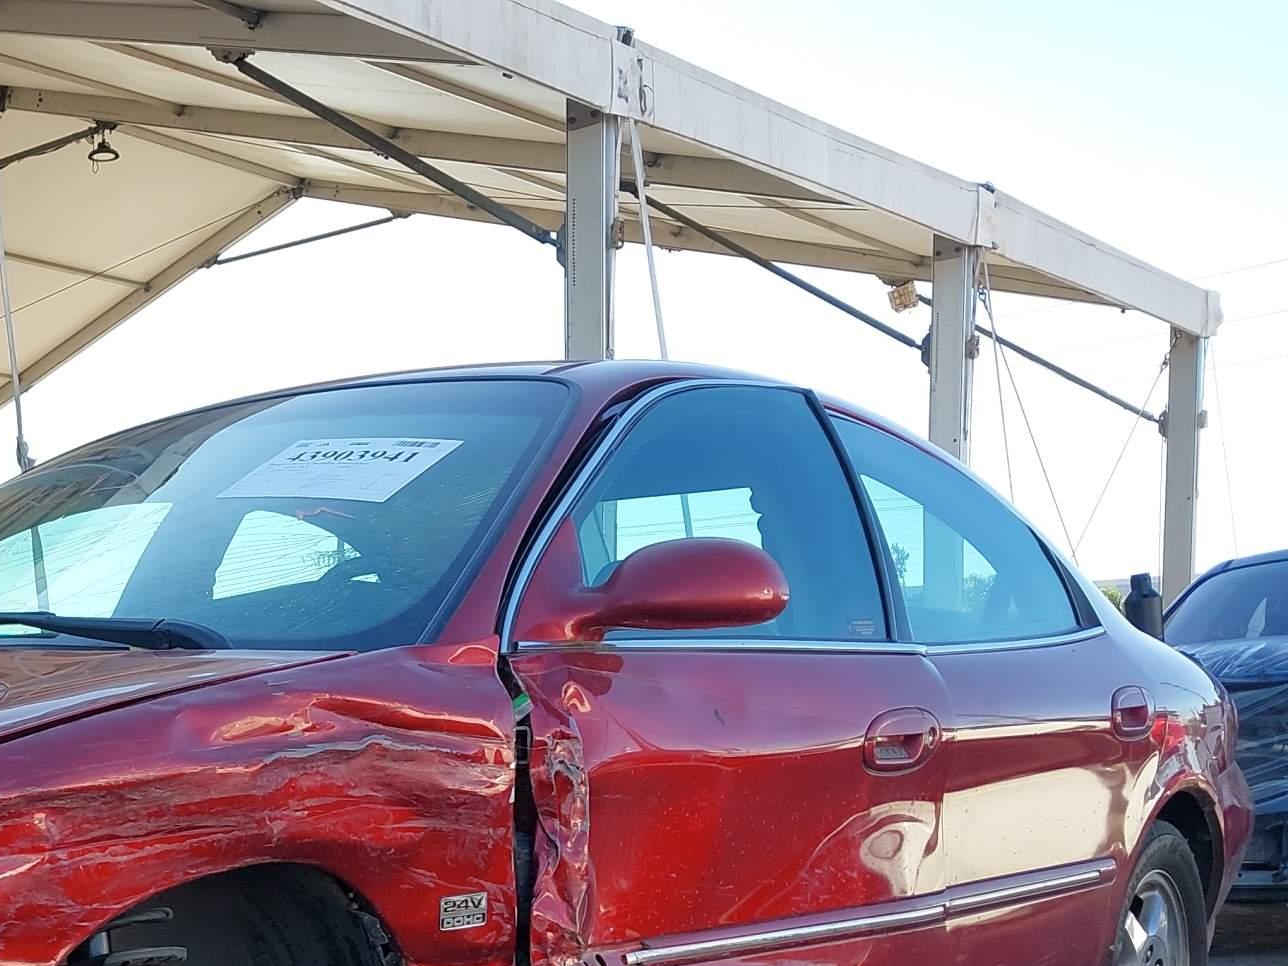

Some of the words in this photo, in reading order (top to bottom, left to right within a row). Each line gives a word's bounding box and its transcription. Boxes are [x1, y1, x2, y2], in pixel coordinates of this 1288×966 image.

[286, 450, 420, 463] 43903941
[443, 895, 484, 912] 24V
[443, 914, 484, 928] DOHC
